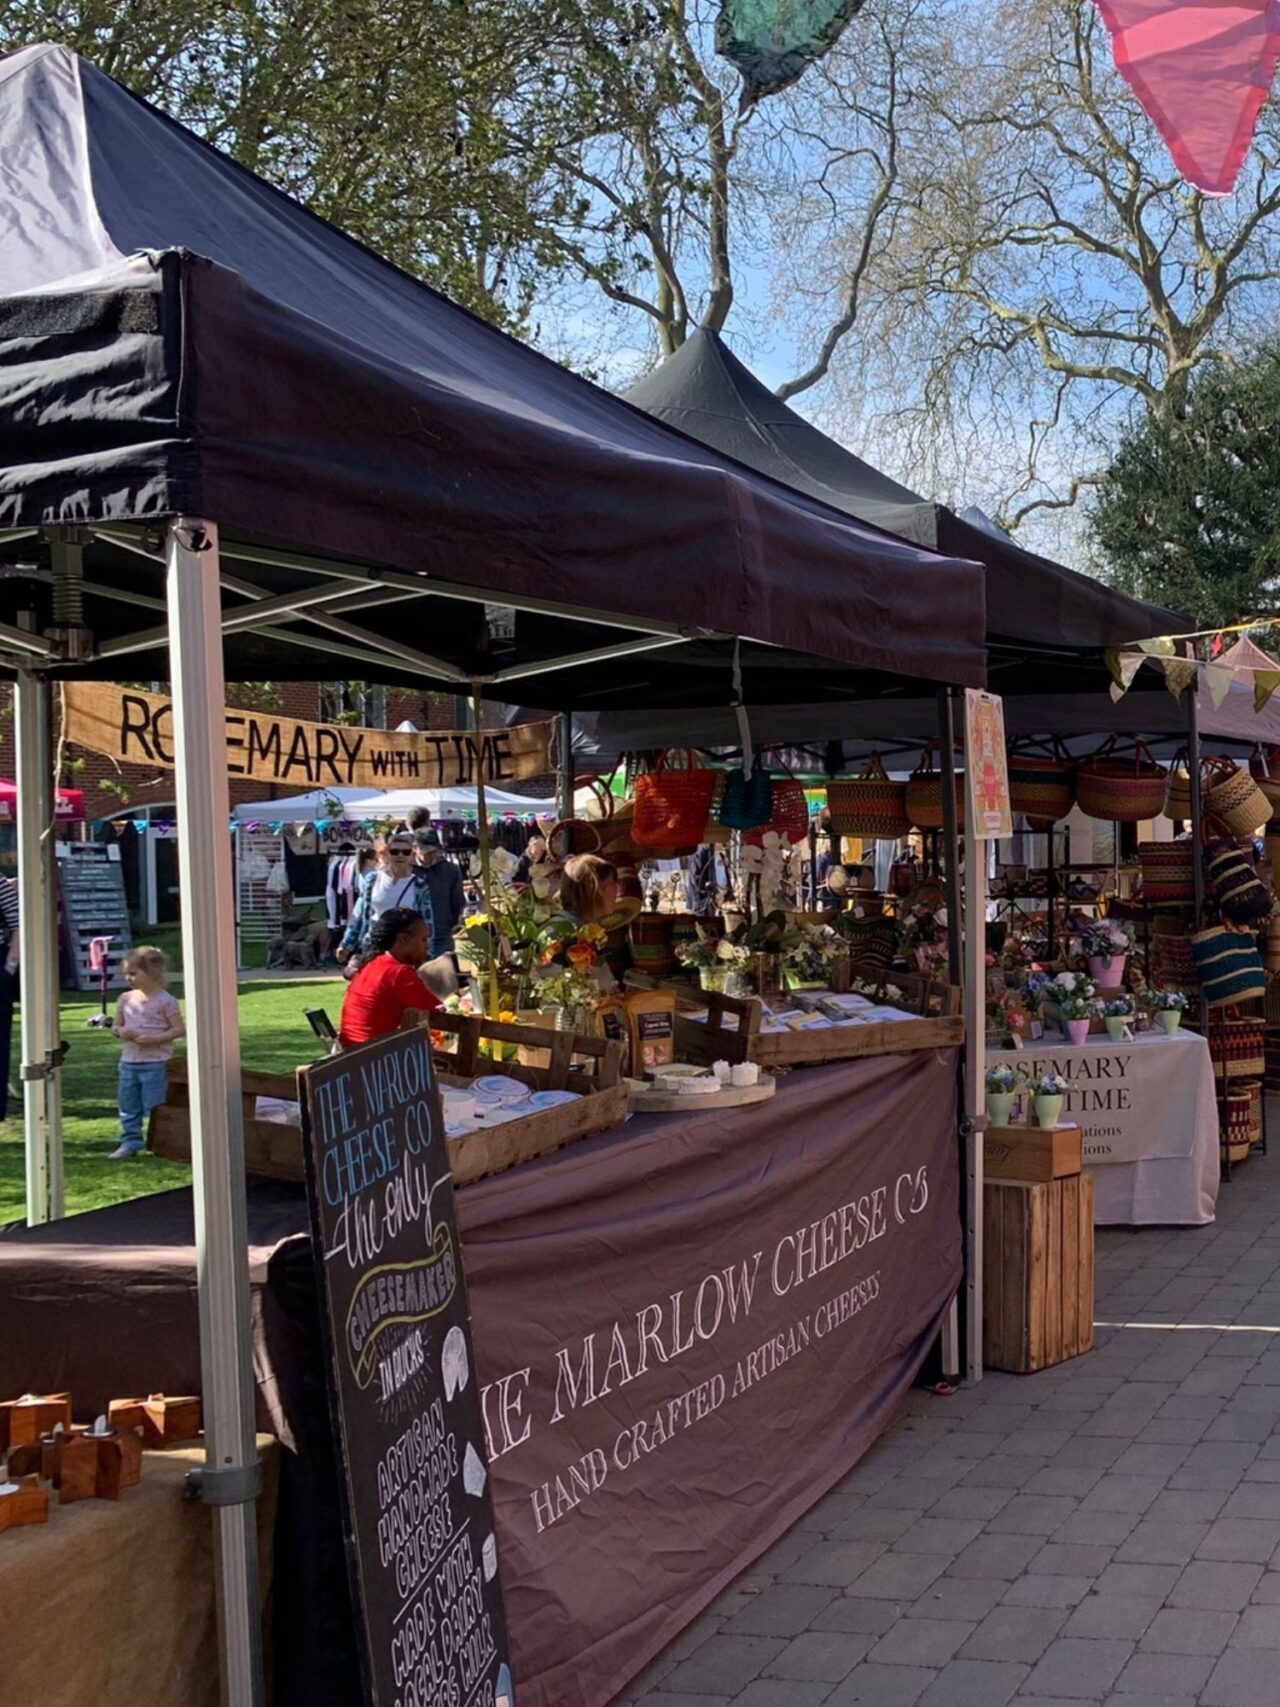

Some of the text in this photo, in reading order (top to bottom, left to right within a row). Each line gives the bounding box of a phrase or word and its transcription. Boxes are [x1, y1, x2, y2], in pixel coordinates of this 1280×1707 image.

[121, 695, 515, 785] ROEMARY WITH TIME
[315, 1040, 431, 1144] THE MARLOW
[323, 1101, 432, 1206] CHEESE CO
[326, 1150, 450, 1269] the only
[351, 1251, 455, 1351] CHEESEMAKER
[550, 1252, 763, 1424] MARLOW
[771, 1186, 887, 1296] CHEESE
[378, 1330, 424, 1400] IN BUCKS
[377, 1398, 445, 1509] ARTISAN
[529, 1448, 608, 1534] HAND
[613, 1373, 726, 1470] CRAFTED
[731, 1316, 814, 1399] ARTISAN
[378, 1433, 458, 1567] HANDMADE
[396, 1492, 453, 1598] CHEESE
[391, 1533, 473, 1687] MADE WITH
[395, 1640, 443, 1707] OCAL
[441, 1567, 482, 1666] DAIRY
[459, 1613, 494, 1692] MILK
